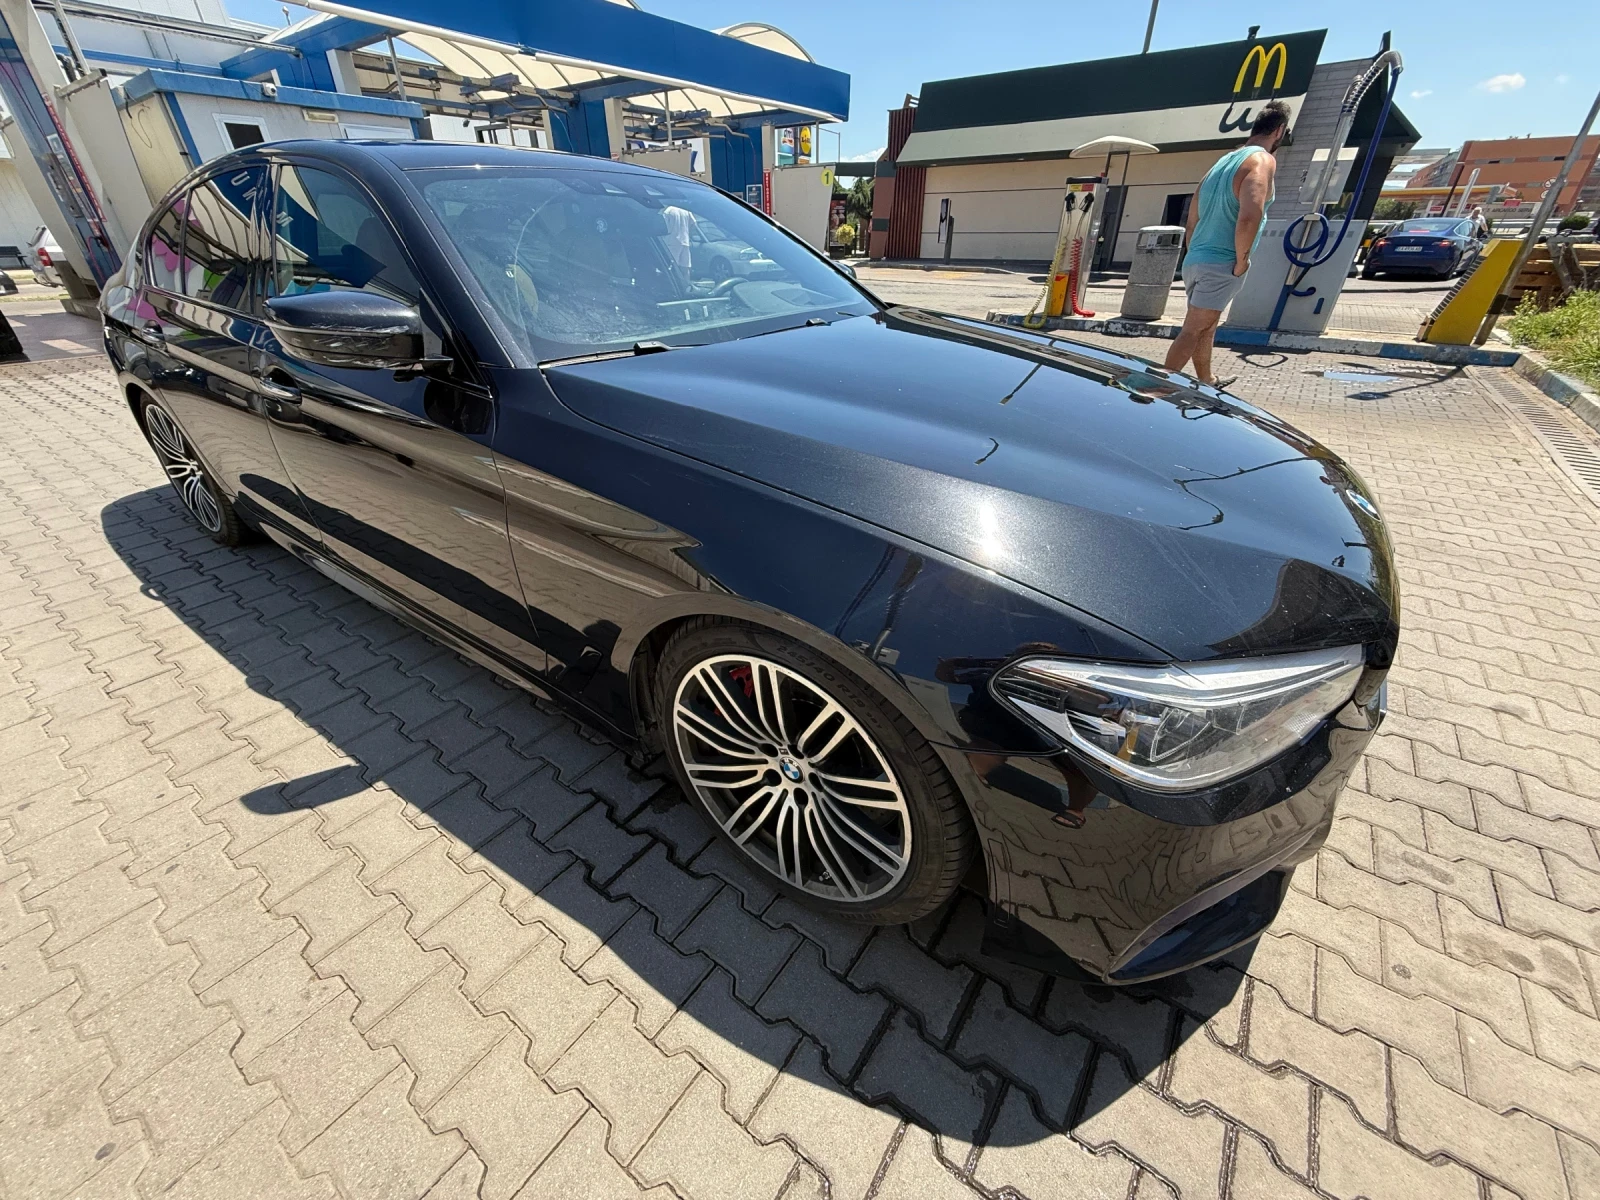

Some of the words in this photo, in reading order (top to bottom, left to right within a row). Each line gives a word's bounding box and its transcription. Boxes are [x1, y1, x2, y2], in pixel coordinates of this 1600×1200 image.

[1233, 42, 1287, 93] M
[824, 171, 830, 185] 1
[776, 645, 836, 682] 245/40
[836, 683, 867, 709] R19
